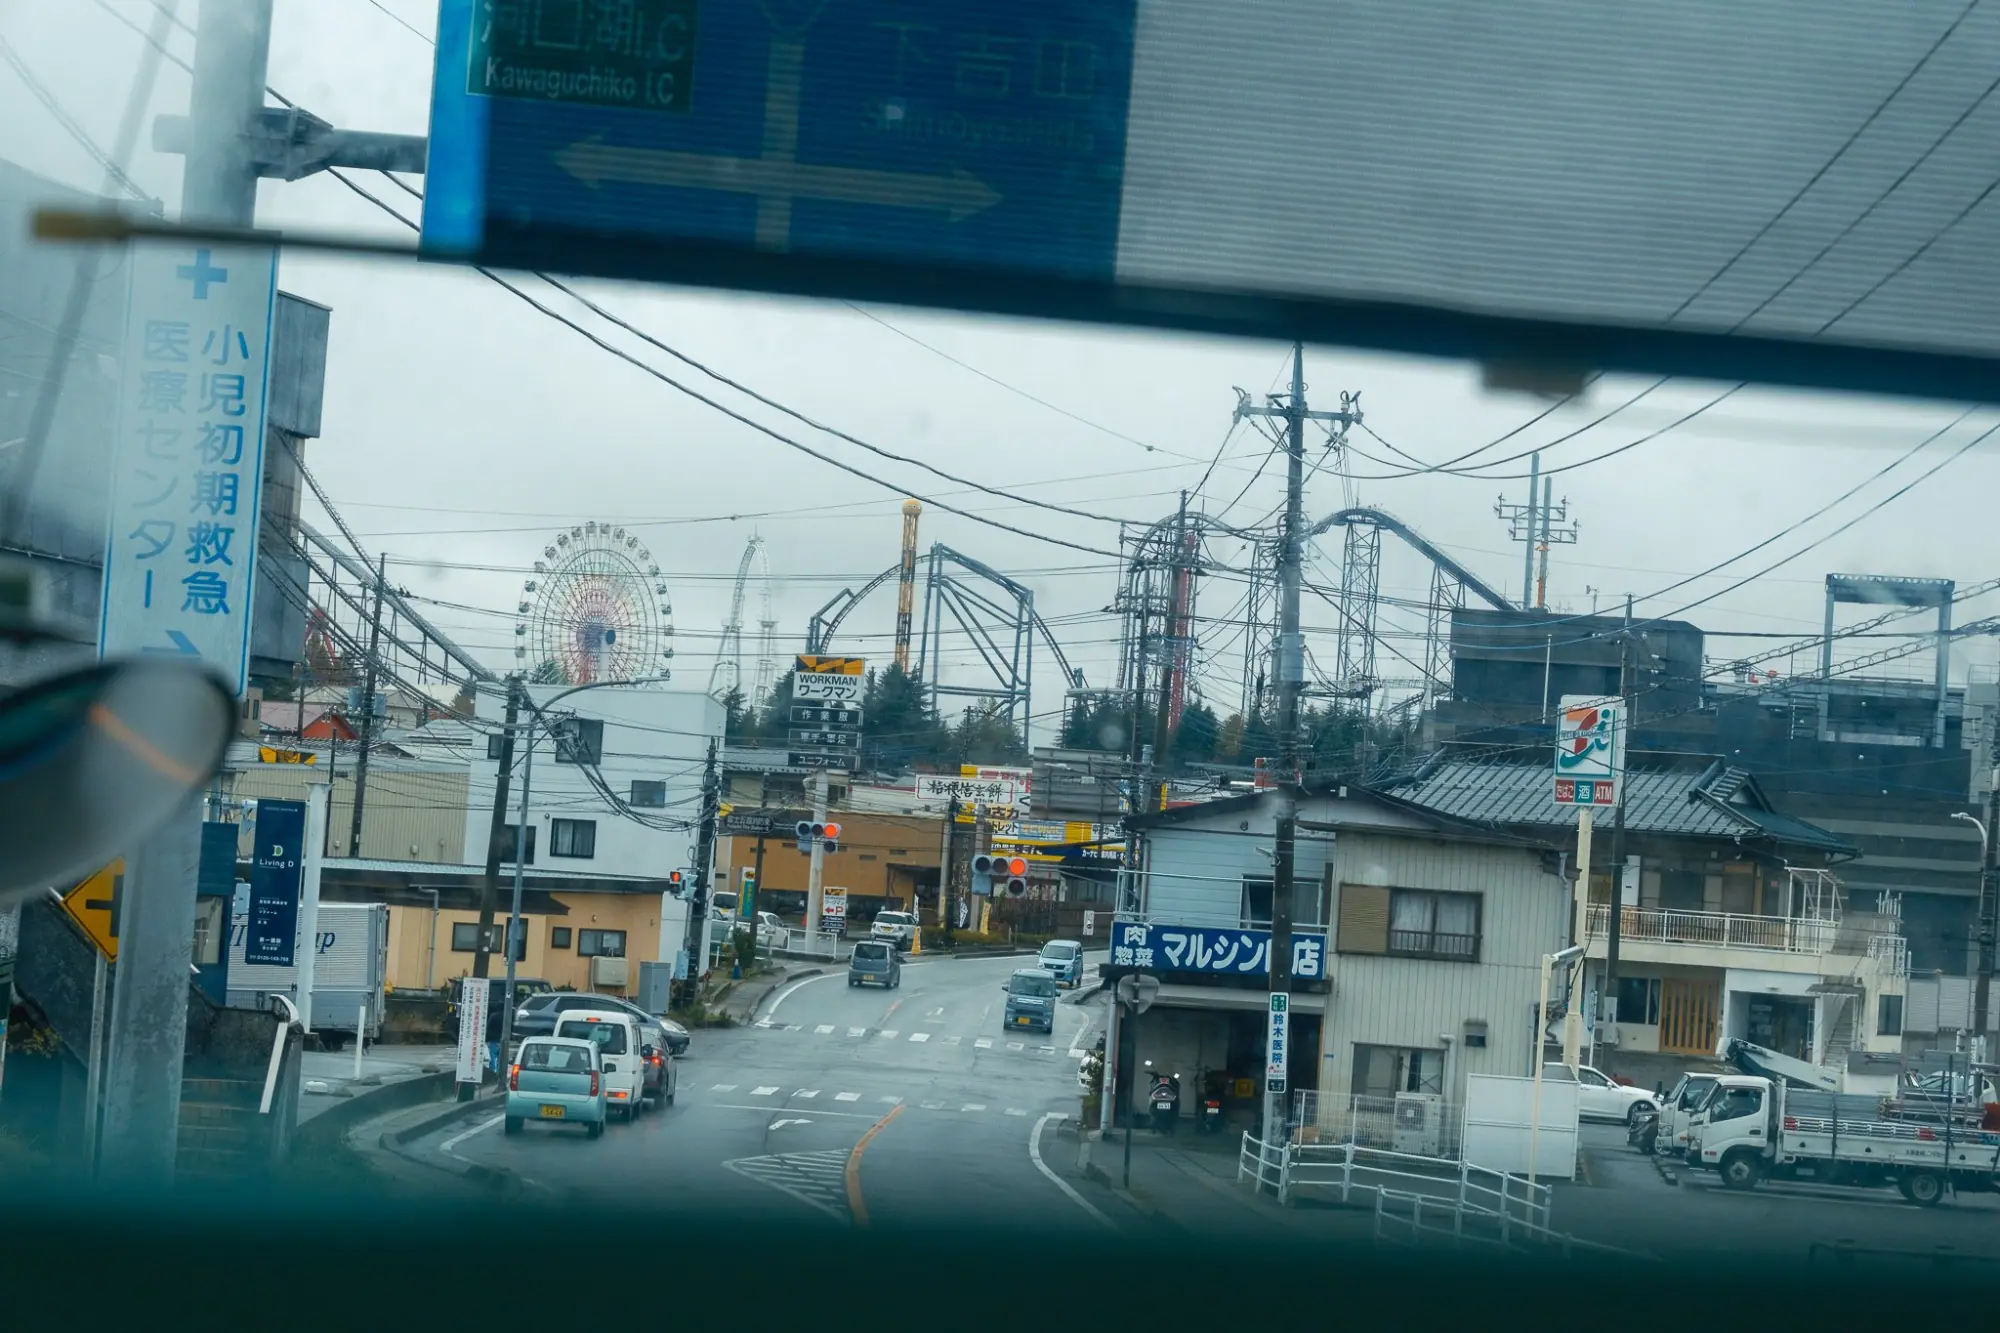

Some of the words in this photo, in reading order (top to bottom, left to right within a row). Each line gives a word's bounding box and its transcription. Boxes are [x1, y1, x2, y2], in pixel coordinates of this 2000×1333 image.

[871, 18, 1099, 100] 下吉田
[485, 56, 636, 100] Kawaguchiko
[129, 319, 190, 609] 医療センター
[180, 323, 249, 616] 小児初期救急
[799, 674, 858, 686] WORKMAN
[798, 684, 857, 699] ワークマン
[797, 755, 846, 768] ユニフォーム
[1556, 785, 1574, 799] たばこ
[1578, 784, 1590, 800] 酒
[1594, 785, 1613, 801] ATM
[259, 858, 285, 869] Living
[287, 859, 295, 868] D
[835, 905, 844, 915] P
[1123, 925, 1147, 946] 肉
[1114, 945, 1155, 967] 惣菜
[1161, 932, 1321, 976] マルシン店
[1271, 1013, 1284, 1064] 鈴木医院
